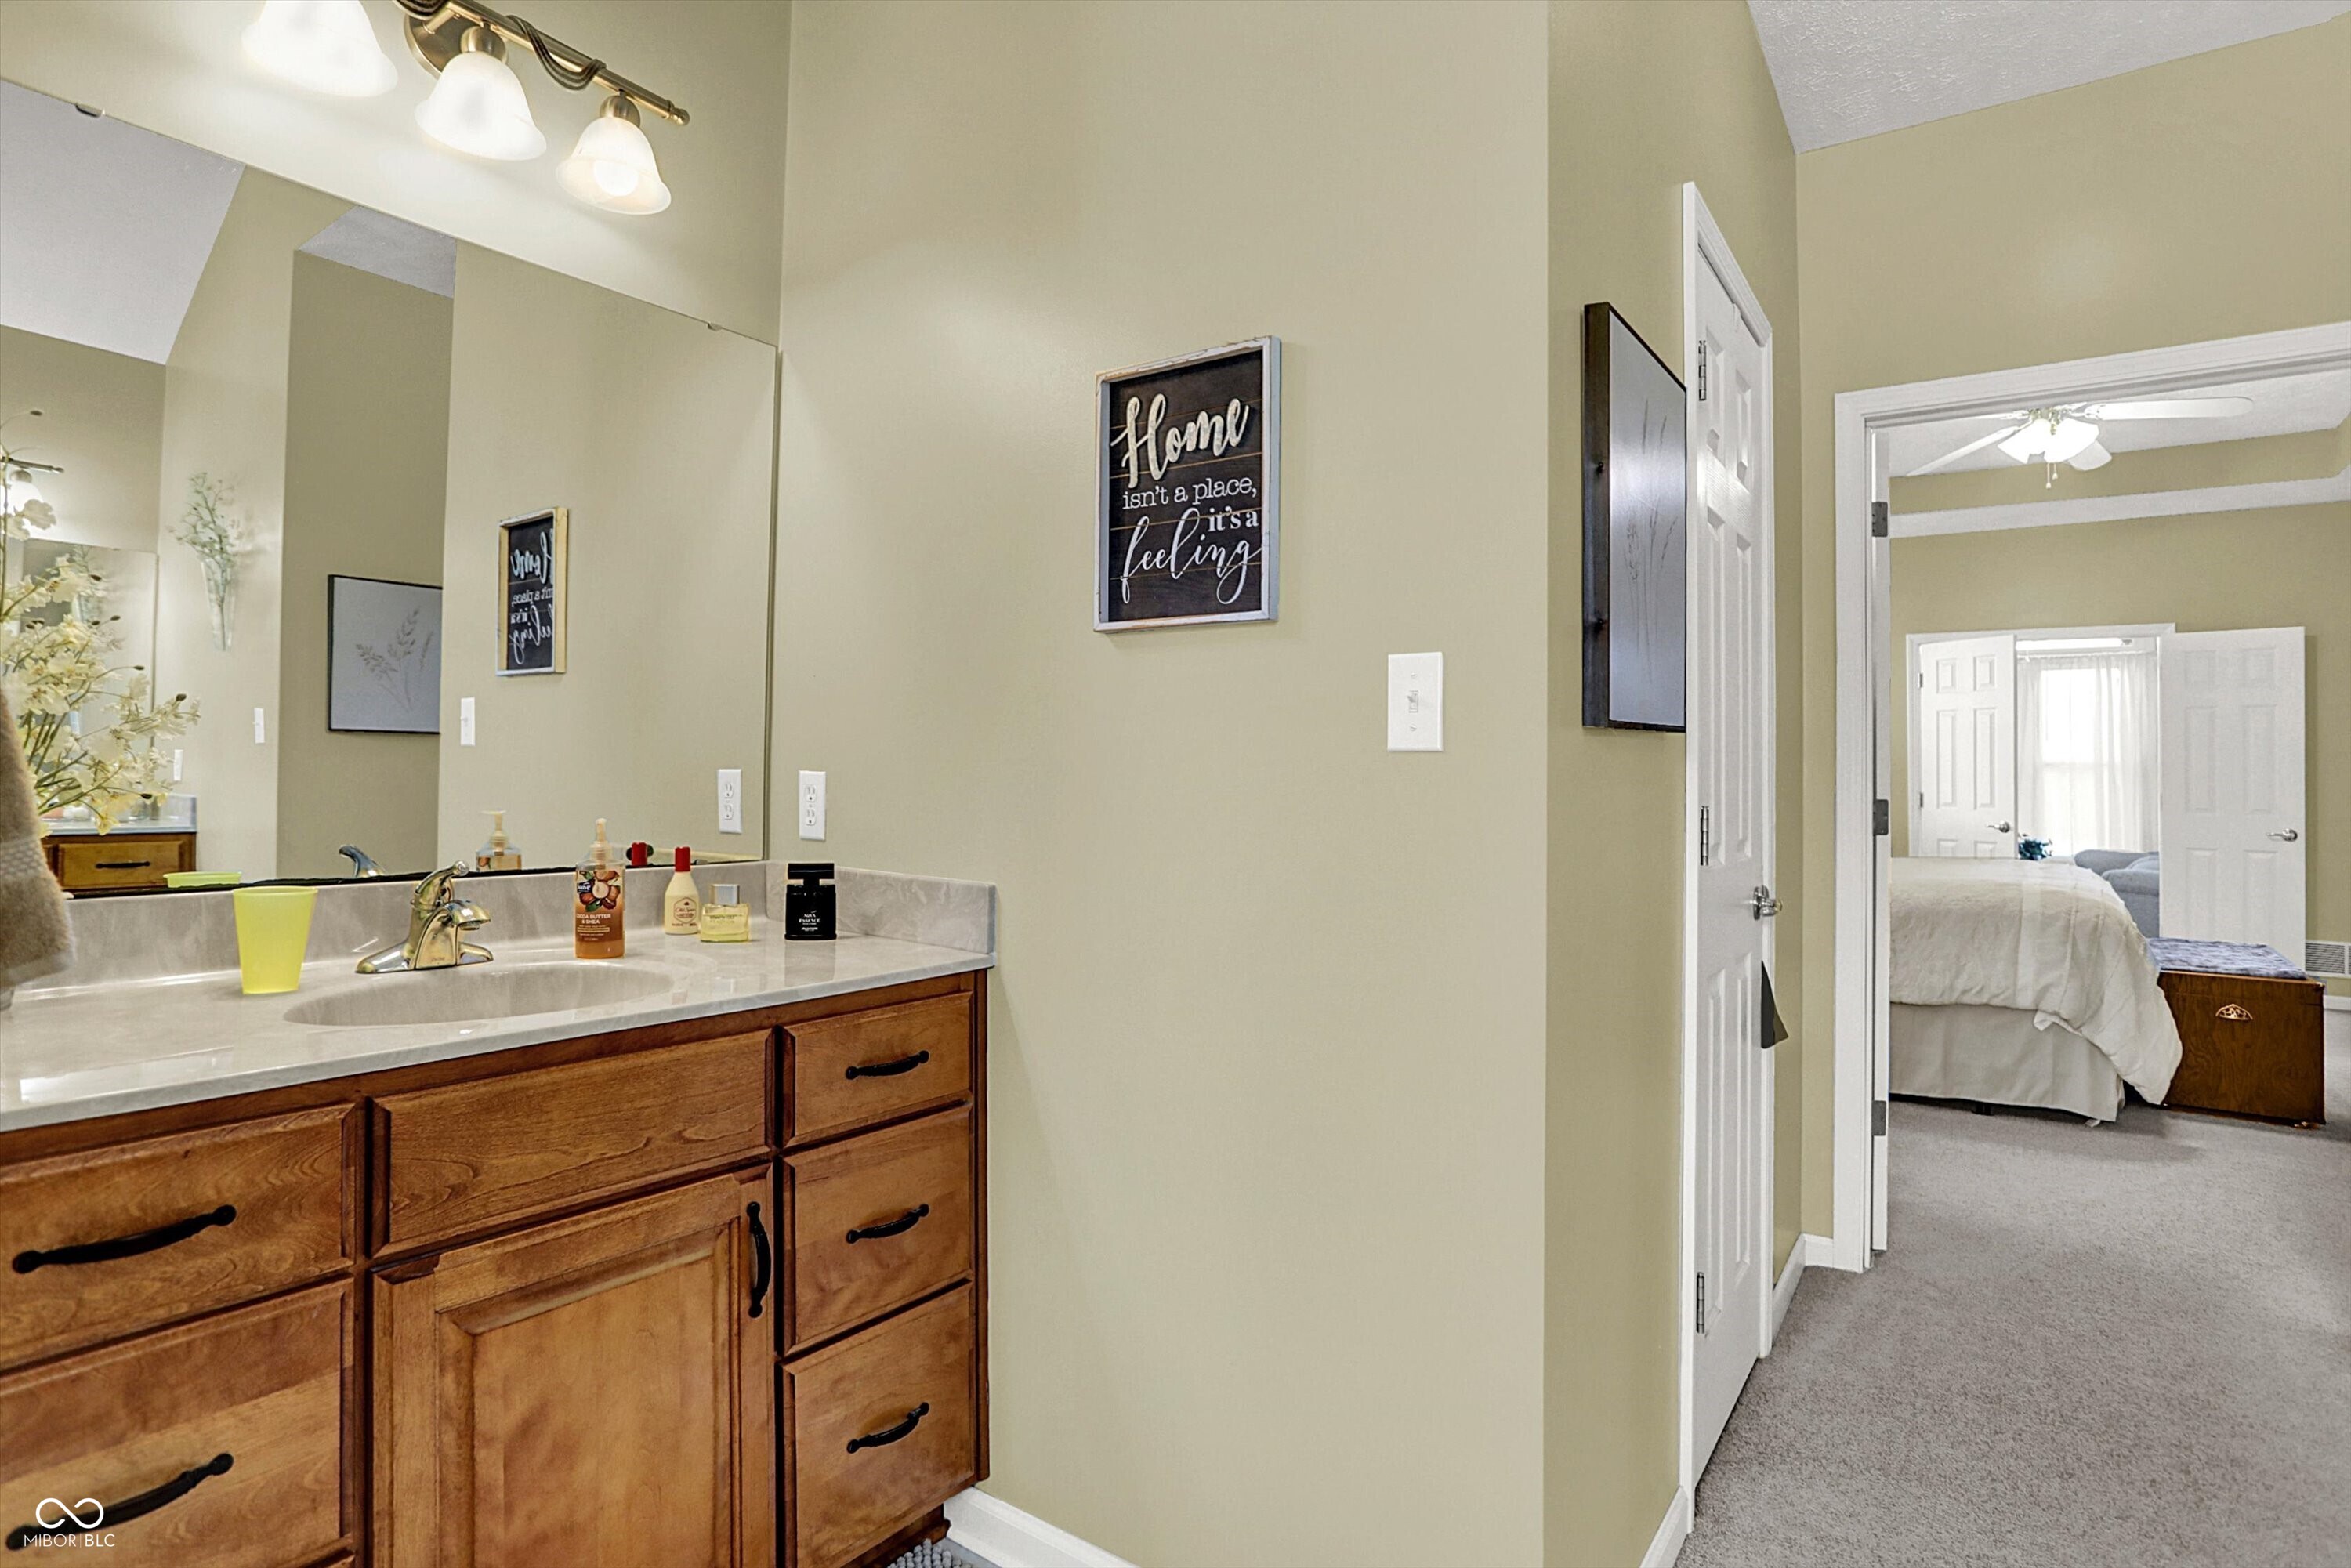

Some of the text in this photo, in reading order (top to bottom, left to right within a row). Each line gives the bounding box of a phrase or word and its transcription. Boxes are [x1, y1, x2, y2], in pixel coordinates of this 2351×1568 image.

[1110, 393, 1250, 488] Home
[1122, 477, 1257, 510] isn't a place,
[1208, 505, 1259, 532] it's a
[1120, 508, 1263, 605] feeling
